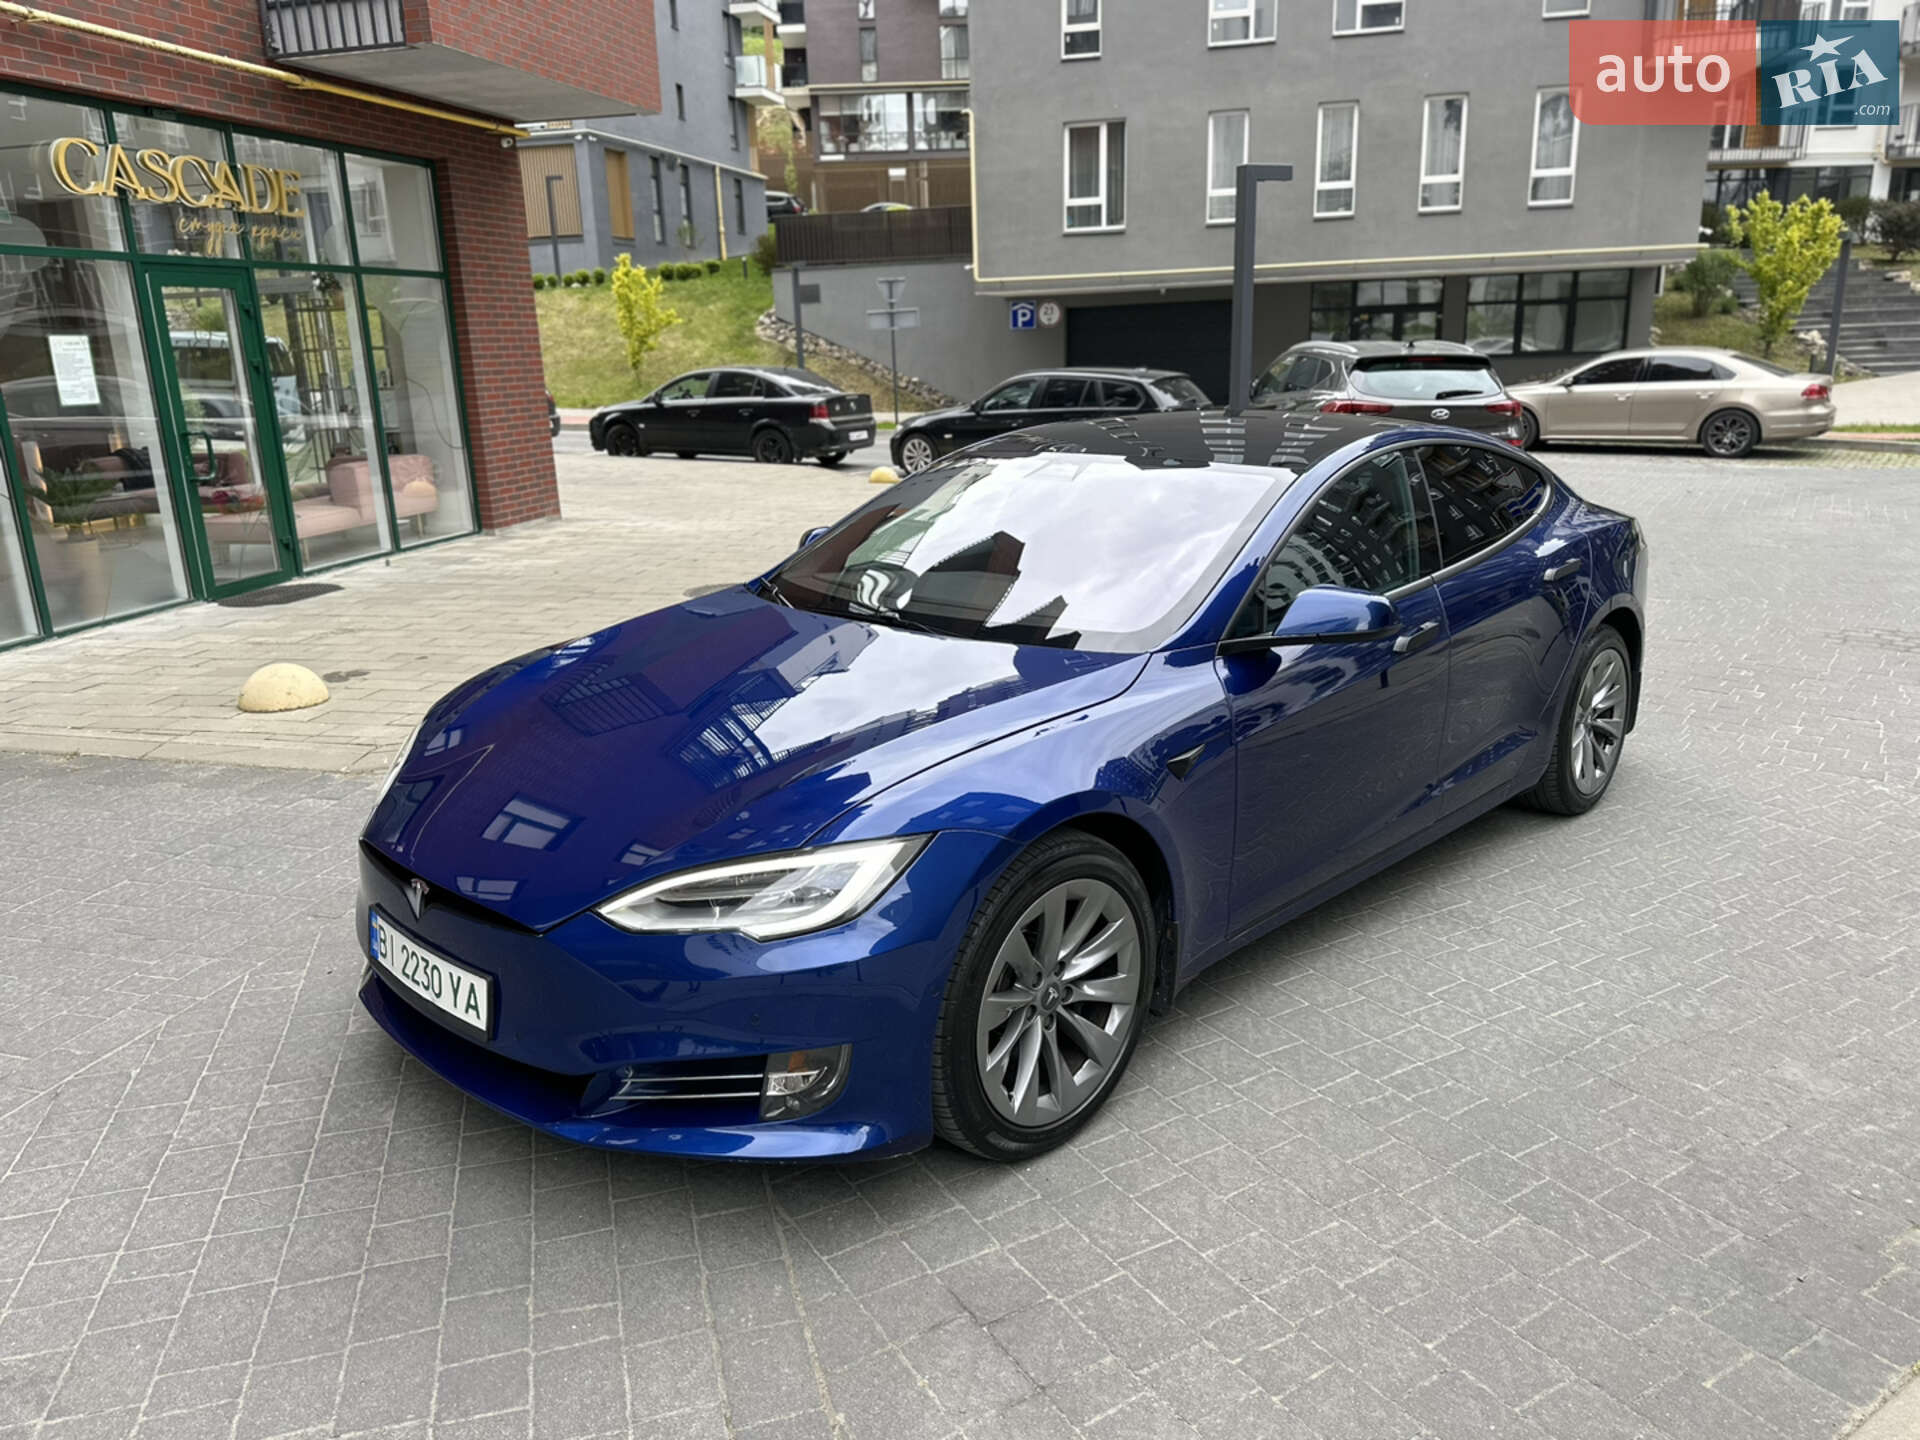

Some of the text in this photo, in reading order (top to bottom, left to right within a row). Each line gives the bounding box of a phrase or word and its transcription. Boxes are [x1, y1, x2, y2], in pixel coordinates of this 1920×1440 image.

[50, 136, 305, 217] CASCADE
[1017, 308, 1032, 328] P
[378, 924, 481, 1020] BI 2230 YA
